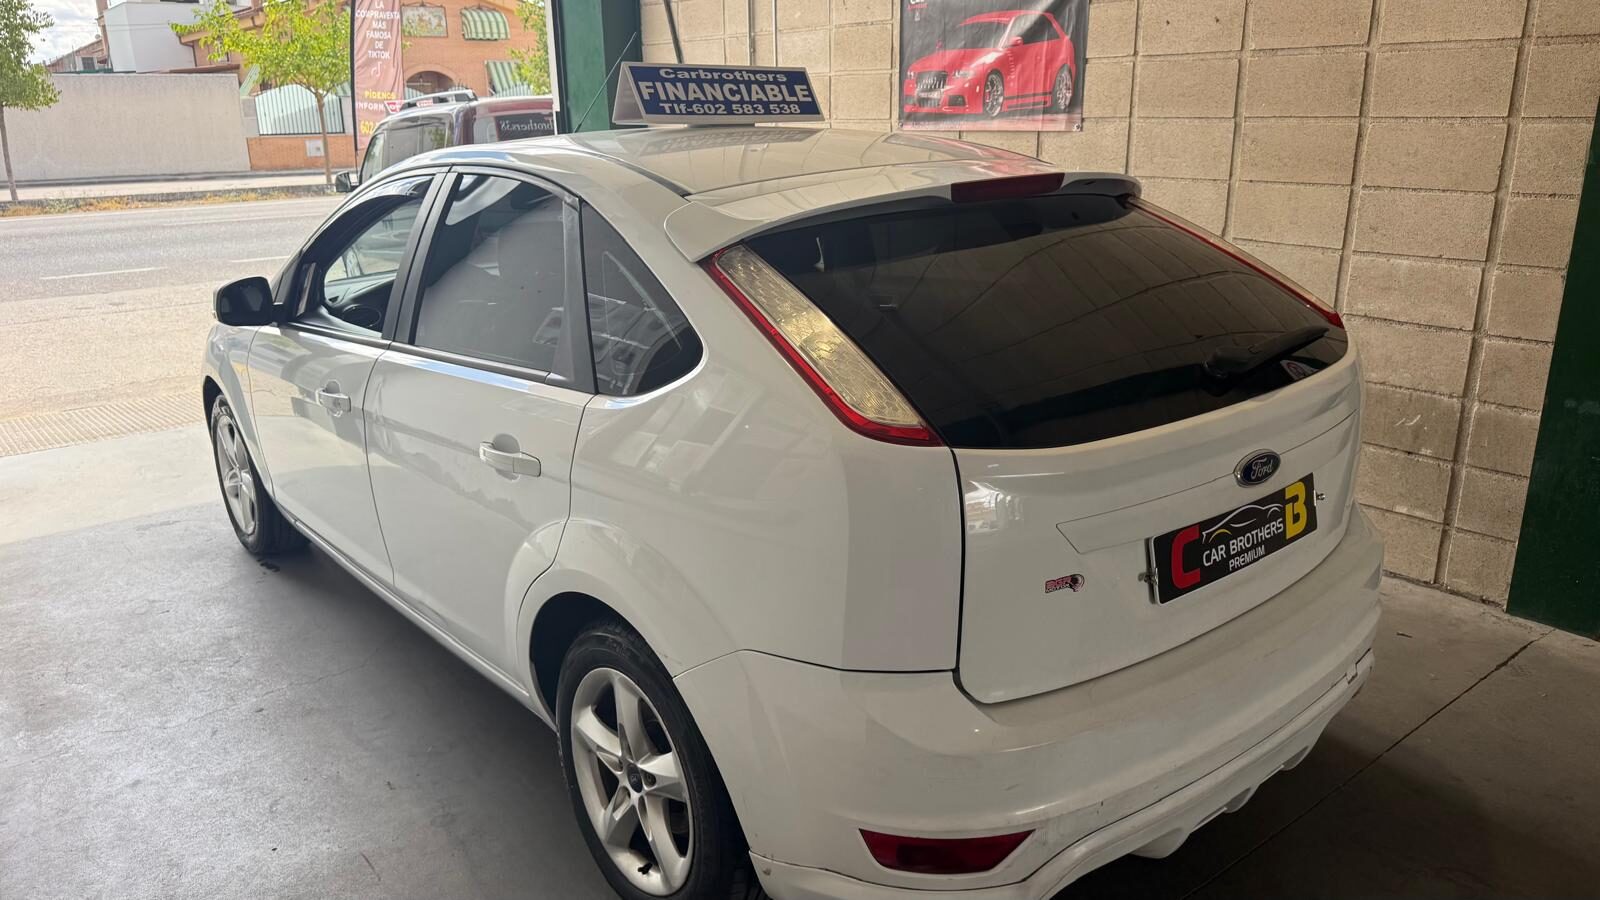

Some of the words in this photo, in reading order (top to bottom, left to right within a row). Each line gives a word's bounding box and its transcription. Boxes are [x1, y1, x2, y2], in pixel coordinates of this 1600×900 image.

[375, 1, 385, 9] LA
[366, 30, 392, 40] FAMOSA
[375, 40, 384, 49] DE
[659, 68, 788, 82] Carbrothers
[637, 81, 812, 102] FINANCIABLE
[356, 101, 386, 111] INFORM
[659, 103, 727, 115] Tlf-602
[732, 103, 765, 115] 583
[769, 103, 801, 115] 538
[1250, 456, 1274, 480] Ford
[1203, 544, 1227, 567] CAR
[1229, 517, 1284, 555] BROTHERS
[1229, 544, 1266, 572] PREMIUM
